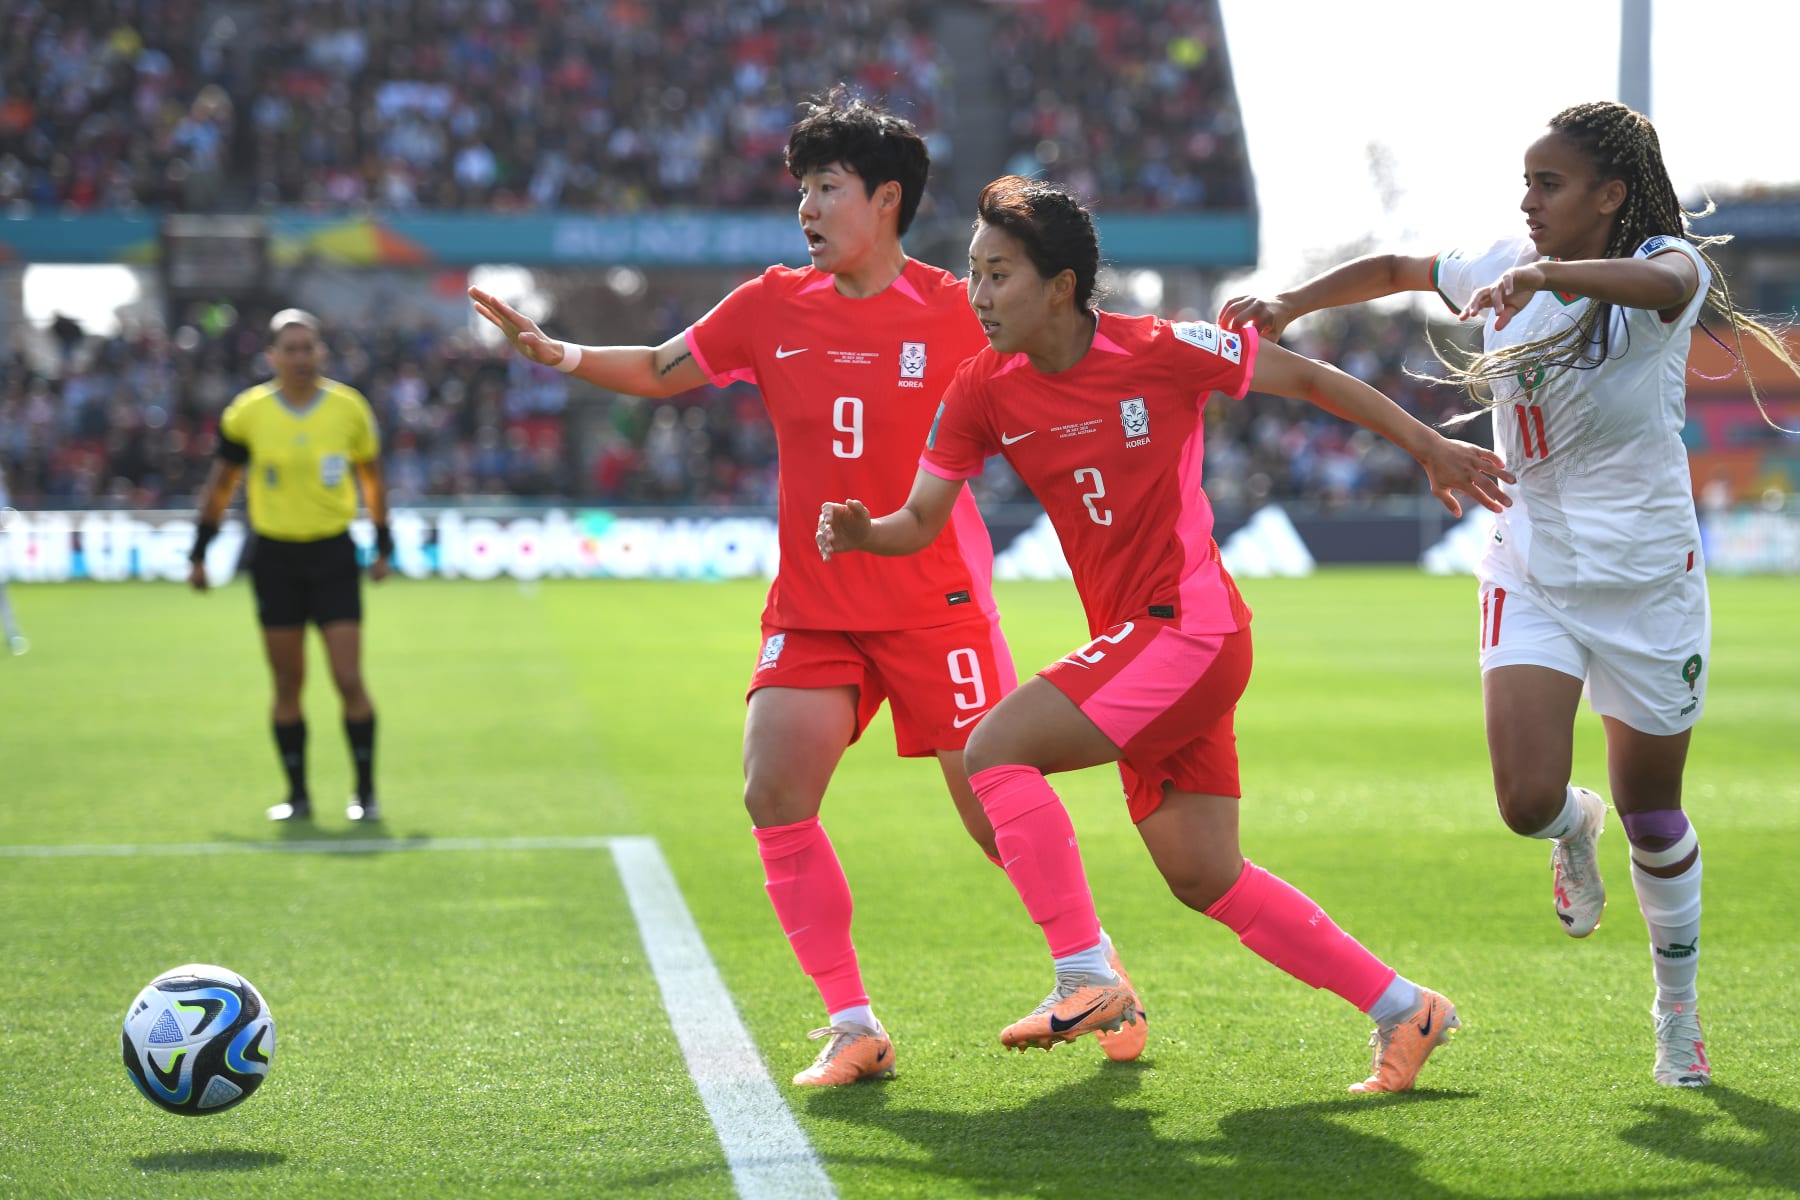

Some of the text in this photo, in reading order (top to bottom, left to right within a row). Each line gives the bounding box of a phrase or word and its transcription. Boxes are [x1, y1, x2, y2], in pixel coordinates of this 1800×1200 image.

[897, 380, 924, 388] KOREA
[833, 397, 864, 459] 9
[1125, 436, 1151, 449] KOREA
[1515, 403, 1549, 460] 11
[1073, 467, 1113, 526] 2
[1481, 588, 1507, 651] 11
[947, 647, 986, 710] 9
